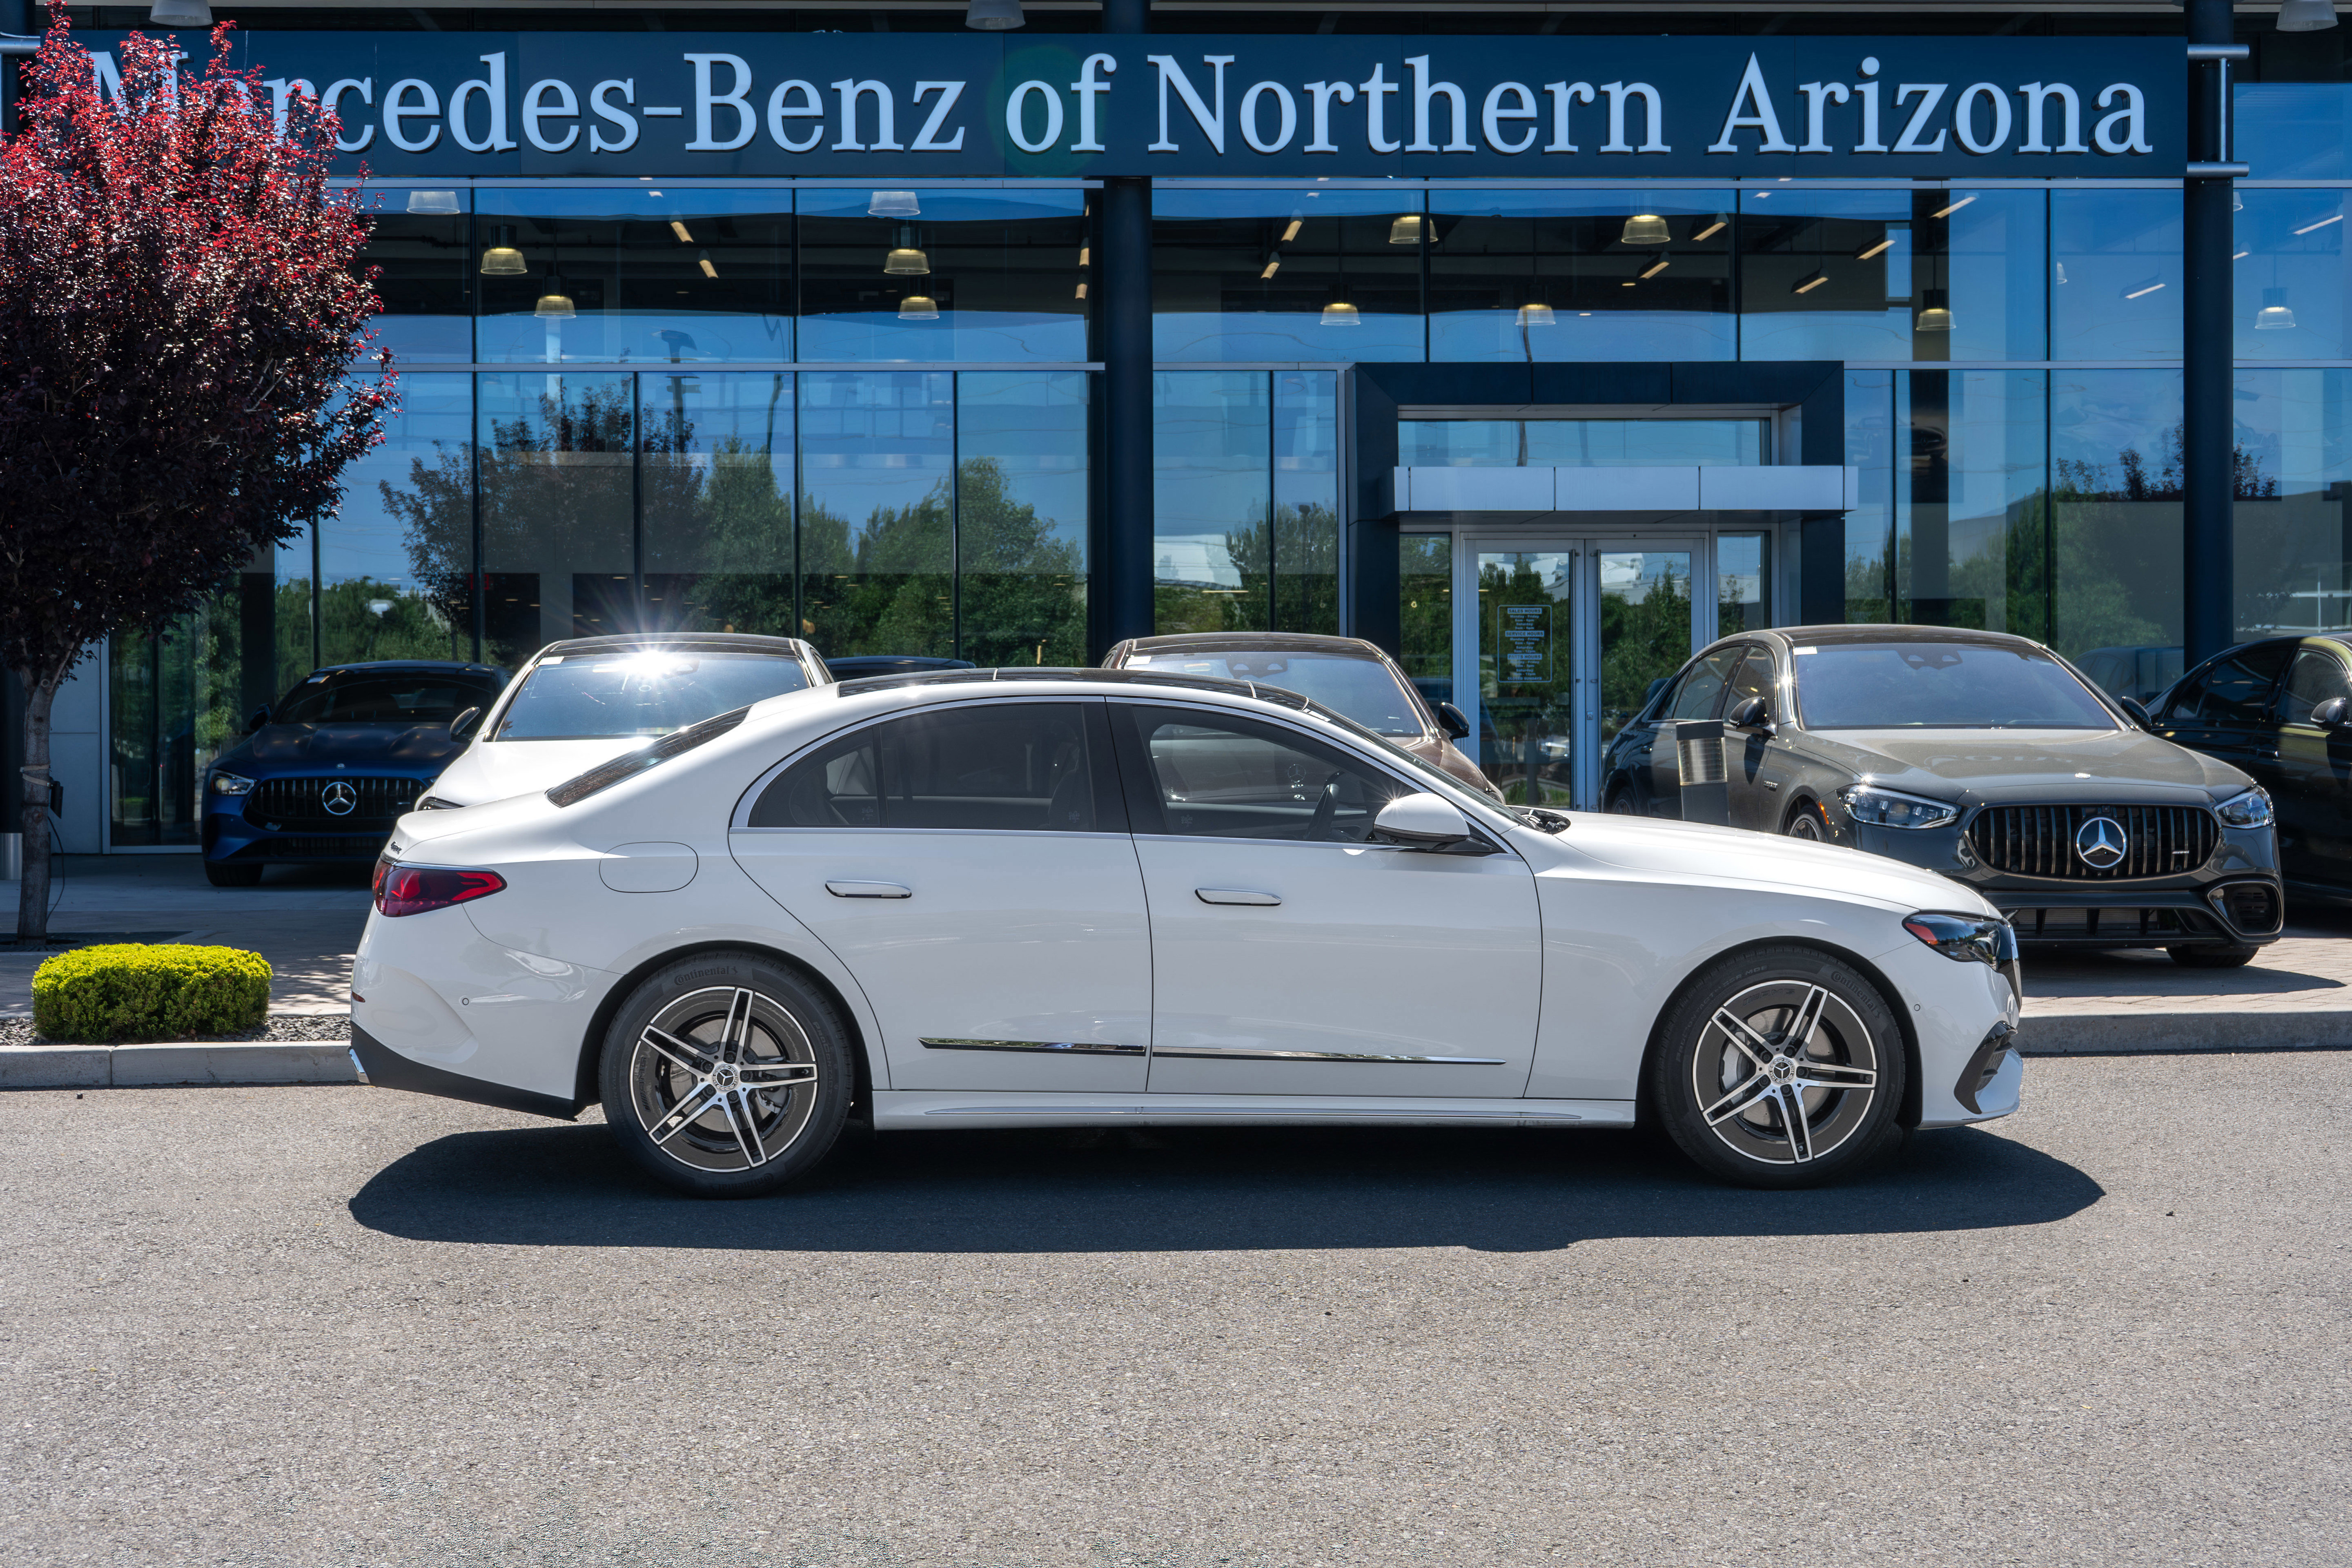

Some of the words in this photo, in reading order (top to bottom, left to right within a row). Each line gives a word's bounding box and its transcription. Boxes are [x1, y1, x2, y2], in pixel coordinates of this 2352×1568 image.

[81, 51, 965, 152] rcedes-Benz
[1006, 53, 1117, 152] of
[1147, 55, 1671, 153] Northern
[1708, 51, 2153, 154] Arizona
[675, 966, 729, 985] Continental
[1831, 971, 1875, 1014] Continental
